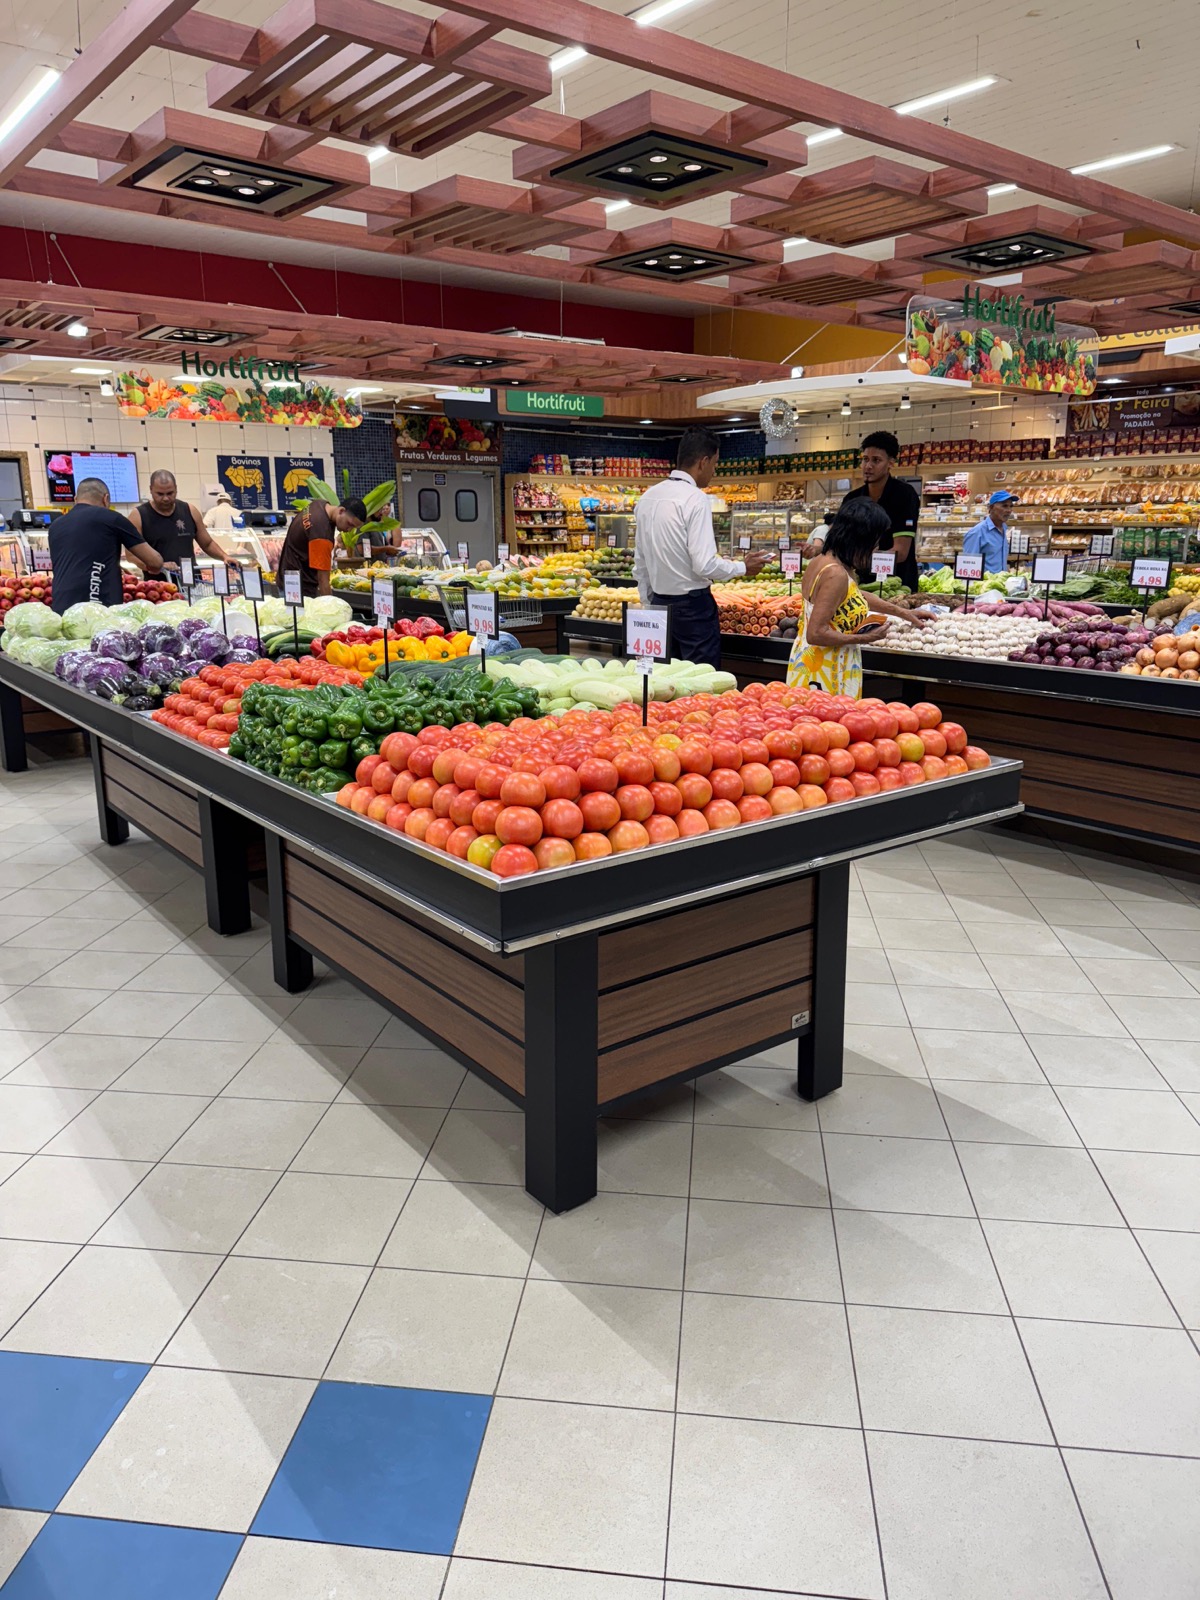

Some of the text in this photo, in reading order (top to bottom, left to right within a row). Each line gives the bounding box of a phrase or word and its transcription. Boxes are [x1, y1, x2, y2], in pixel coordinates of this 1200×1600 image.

[962, 284, 1056, 333] Hortifruti
[181, 350, 302, 383] Hortifruti
[527, 392, 586, 412] Hortifruti
[1133, 398, 1170, 409] Feira
[1124, 420, 1154, 428] PADARIA
[231, 456, 261, 466] Bovinos
[400, 450, 498, 463] Frutas Verduras Legumes
[1138, 575, 1162, 586] 4,98
[474, 617, 493, 633] 9,98
[633, 620, 651, 629] TOMATE
[633, 638, 662, 656] 4,98
